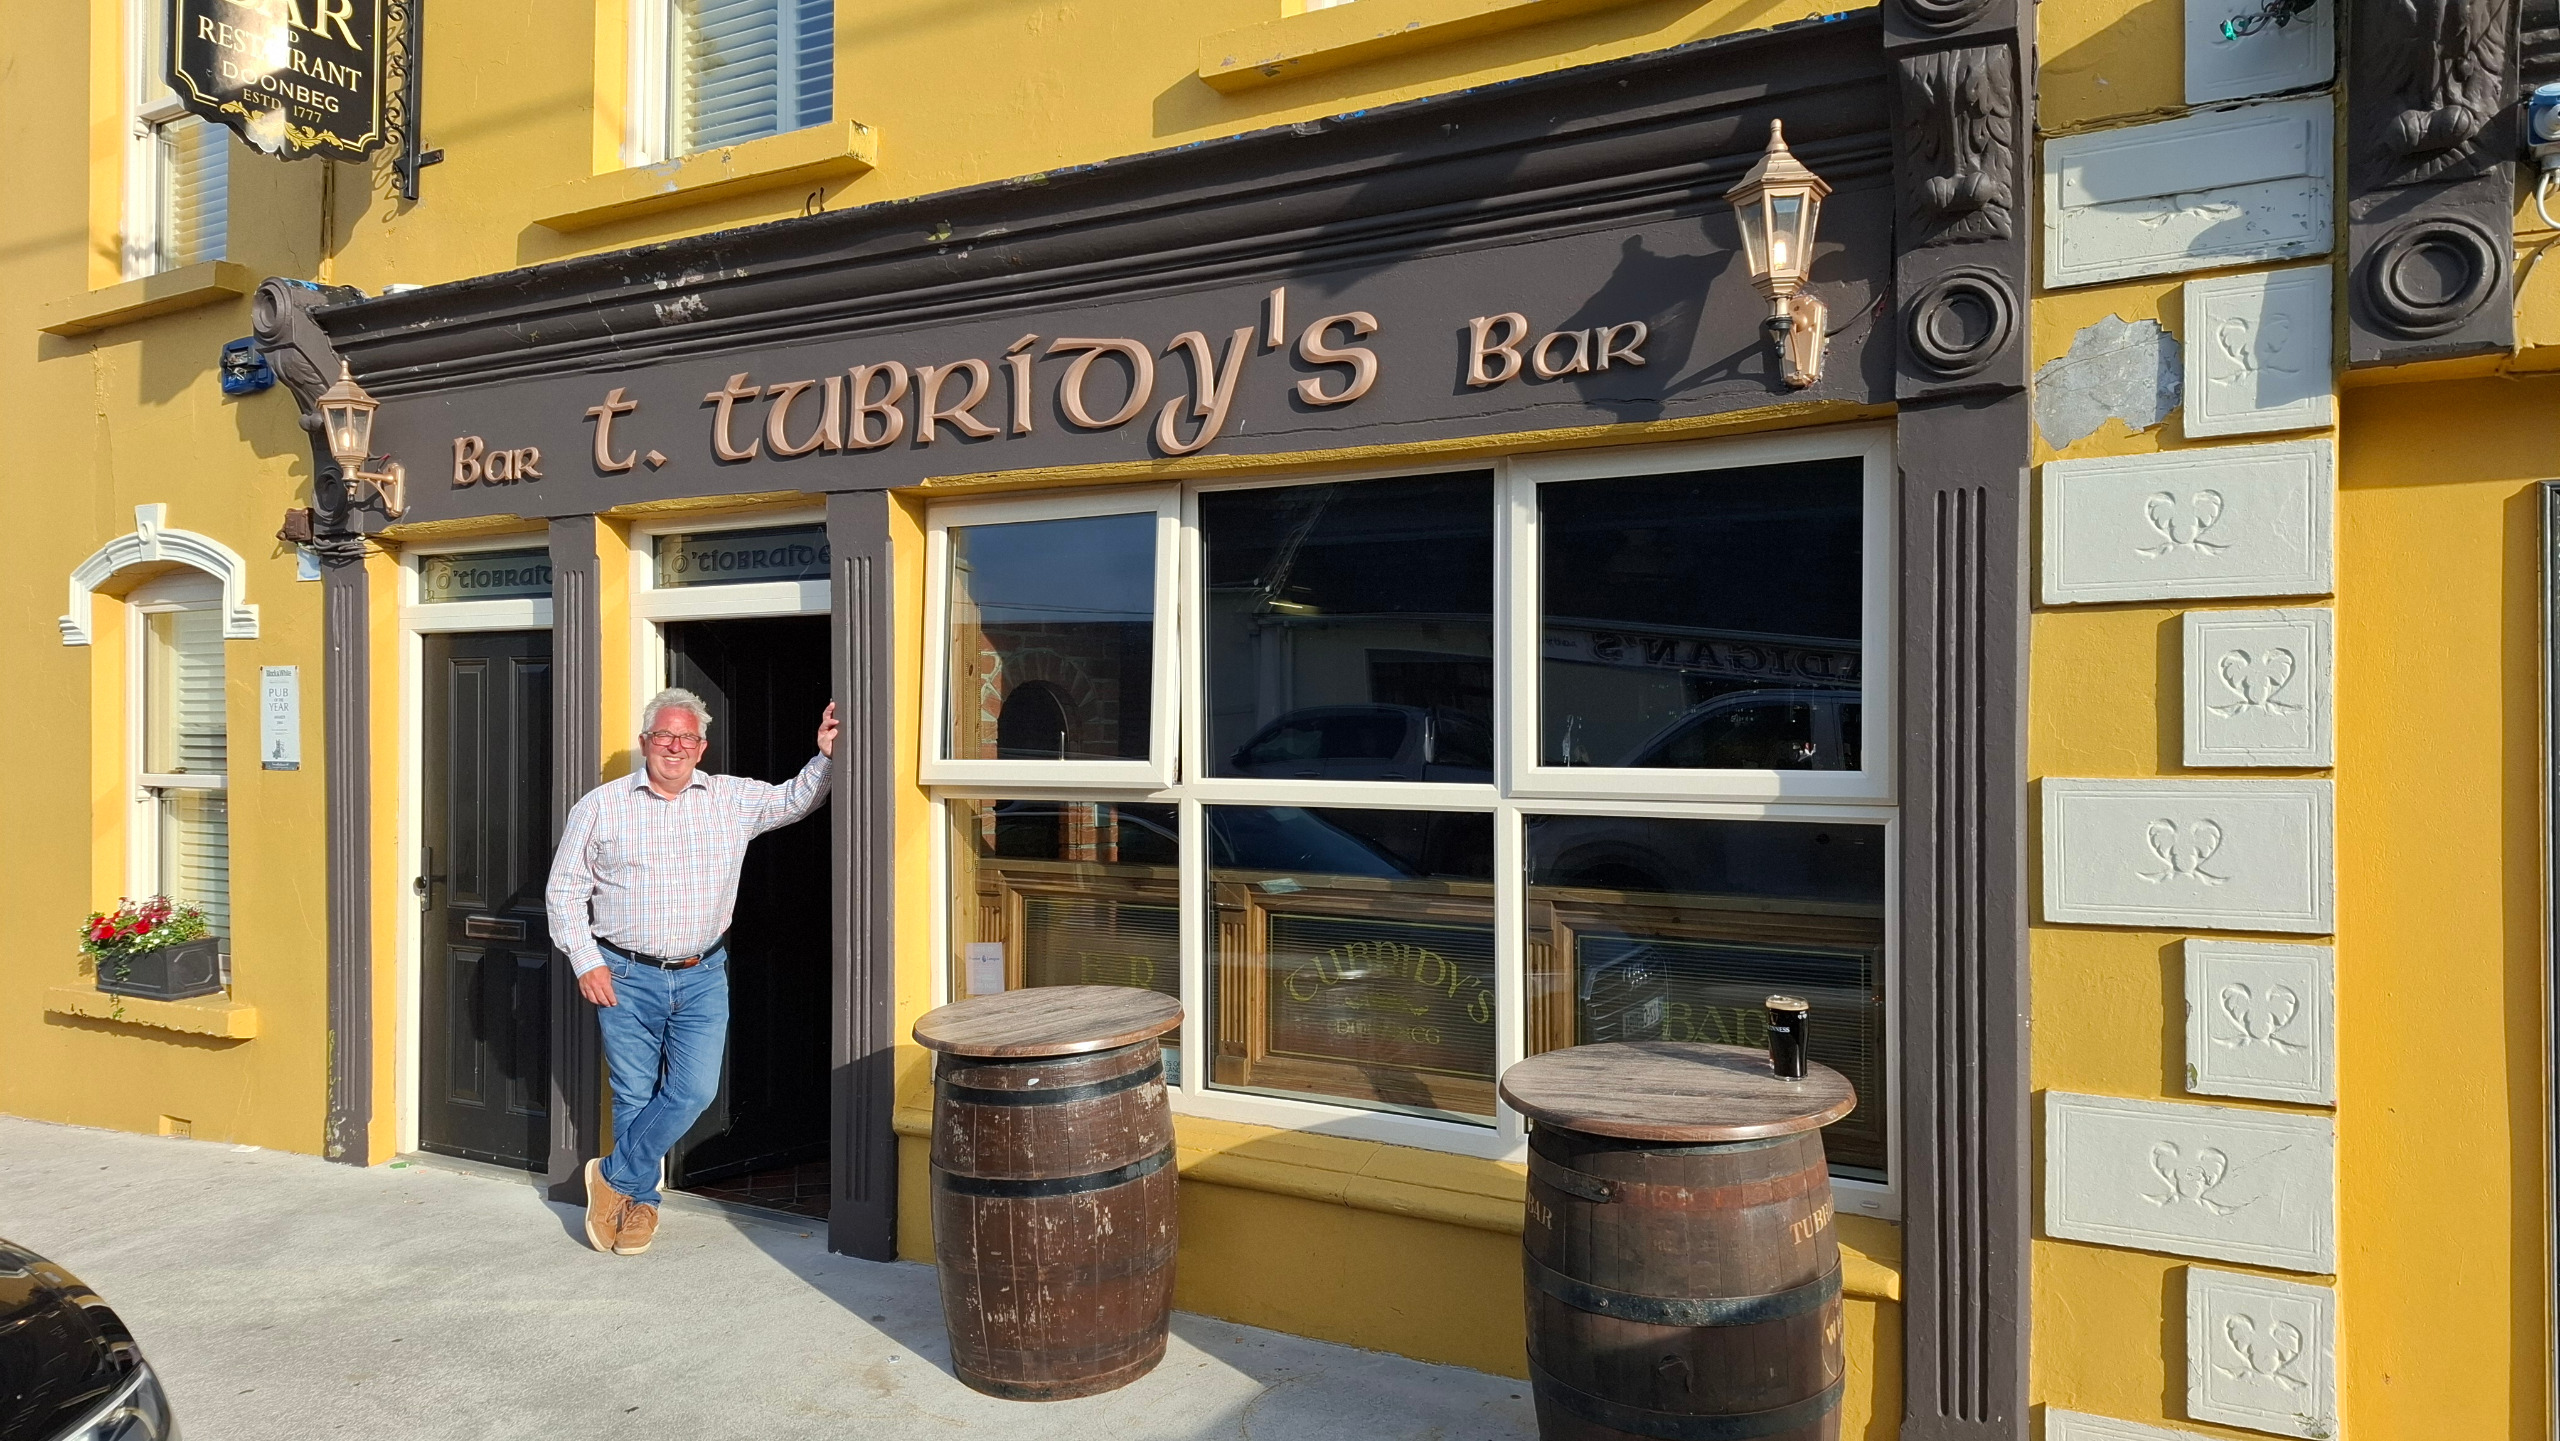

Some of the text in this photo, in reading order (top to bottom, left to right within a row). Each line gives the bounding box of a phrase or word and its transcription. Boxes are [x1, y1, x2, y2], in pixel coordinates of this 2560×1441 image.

[221, 59, 340, 113] DOONBEG
[242, 88, 323, 124] ESTD 1777
[268, 687, 289, 697] PUB
[268, 702, 290, 712] YEAR
[1661, 1001, 1768, 1047] BAR
[1527, 1190, 1553, 1230] BAR
